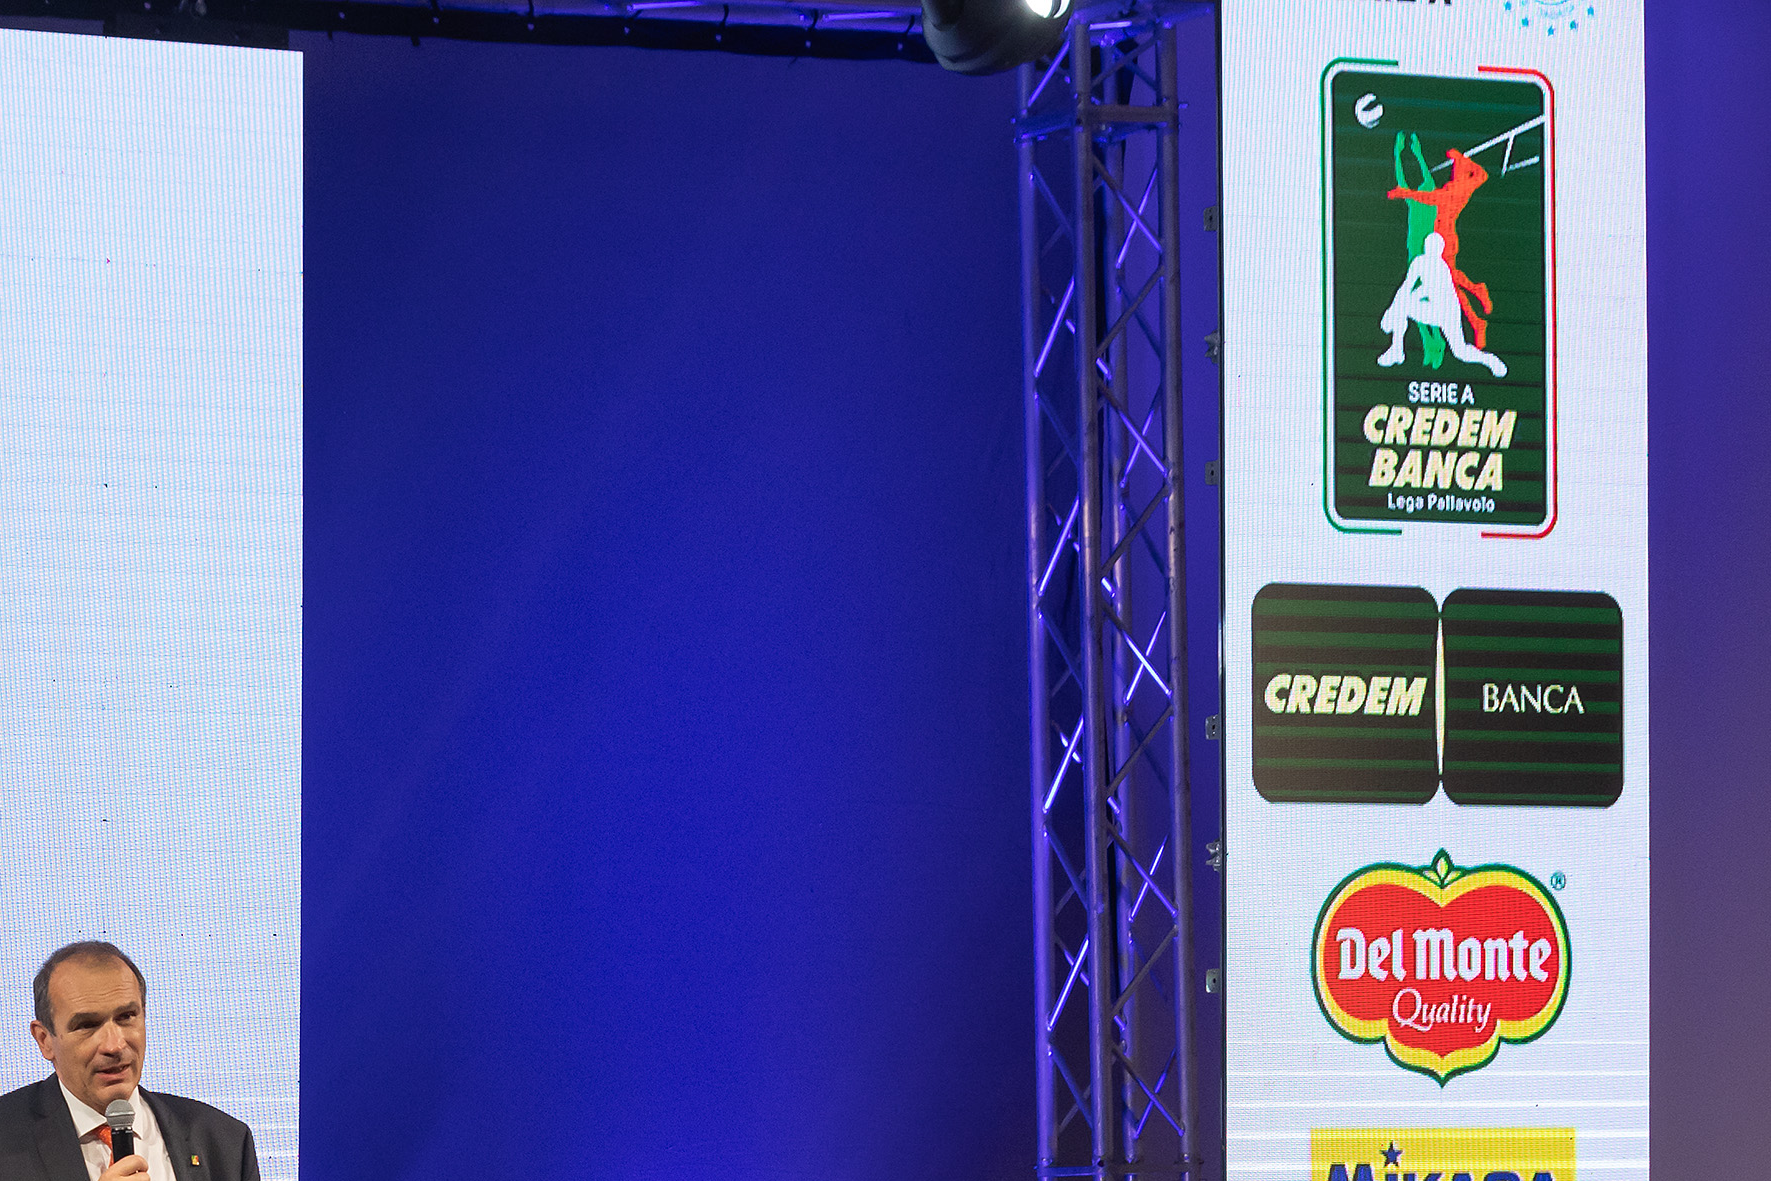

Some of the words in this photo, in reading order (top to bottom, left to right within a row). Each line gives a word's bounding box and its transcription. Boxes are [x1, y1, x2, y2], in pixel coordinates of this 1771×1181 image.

[1408, 381, 1459, 404] SERIE
[1459, 383, 1475, 406] A
[1363, 404, 1518, 450] CREDEM
[1368, 447, 1505, 492] BANCA
[1386, 493, 1424, 514] Lega
[1427, 493, 1496, 515] Pallavolo
[1263, 674, 1428, 717] CREDEM
[1481, 682, 1586, 715] BANCA
[1335, 927, 1407, 982] Del
[1412, 927, 1552, 983] Monte
[1392, 987, 1492, 1033] Quality
